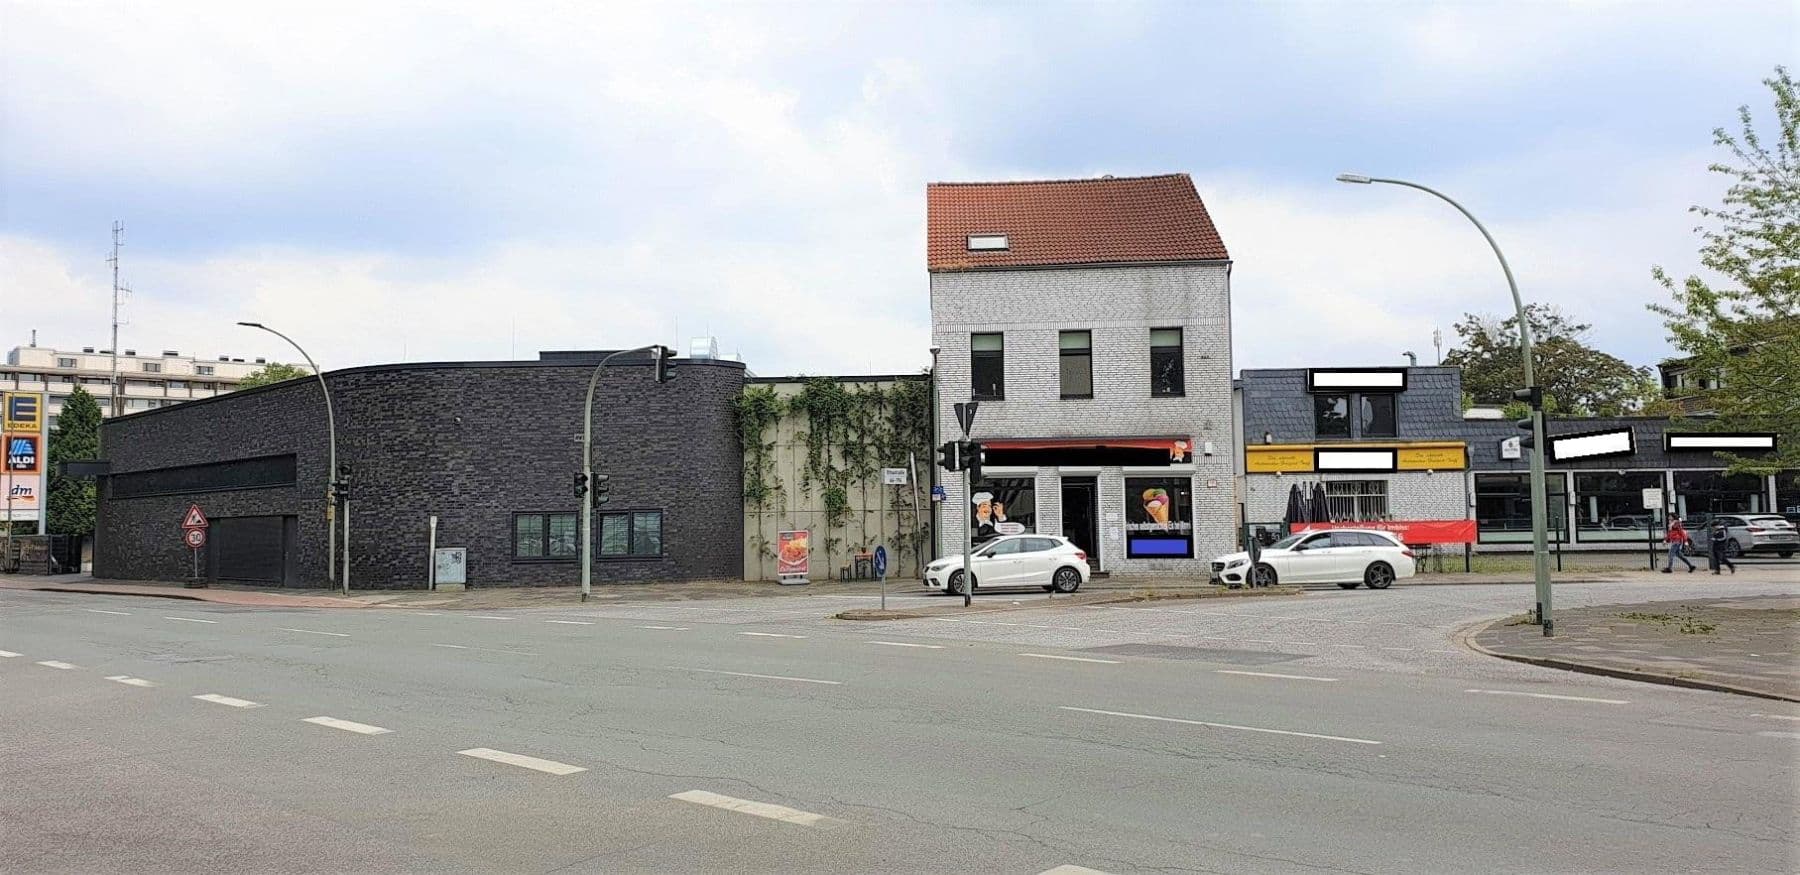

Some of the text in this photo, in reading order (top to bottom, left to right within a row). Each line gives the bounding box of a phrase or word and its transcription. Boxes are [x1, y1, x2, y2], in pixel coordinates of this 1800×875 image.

[8, 456, 35, 464] ALDI
[11, 484, 32, 495] dm
[190, 533, 202, 543] 30
